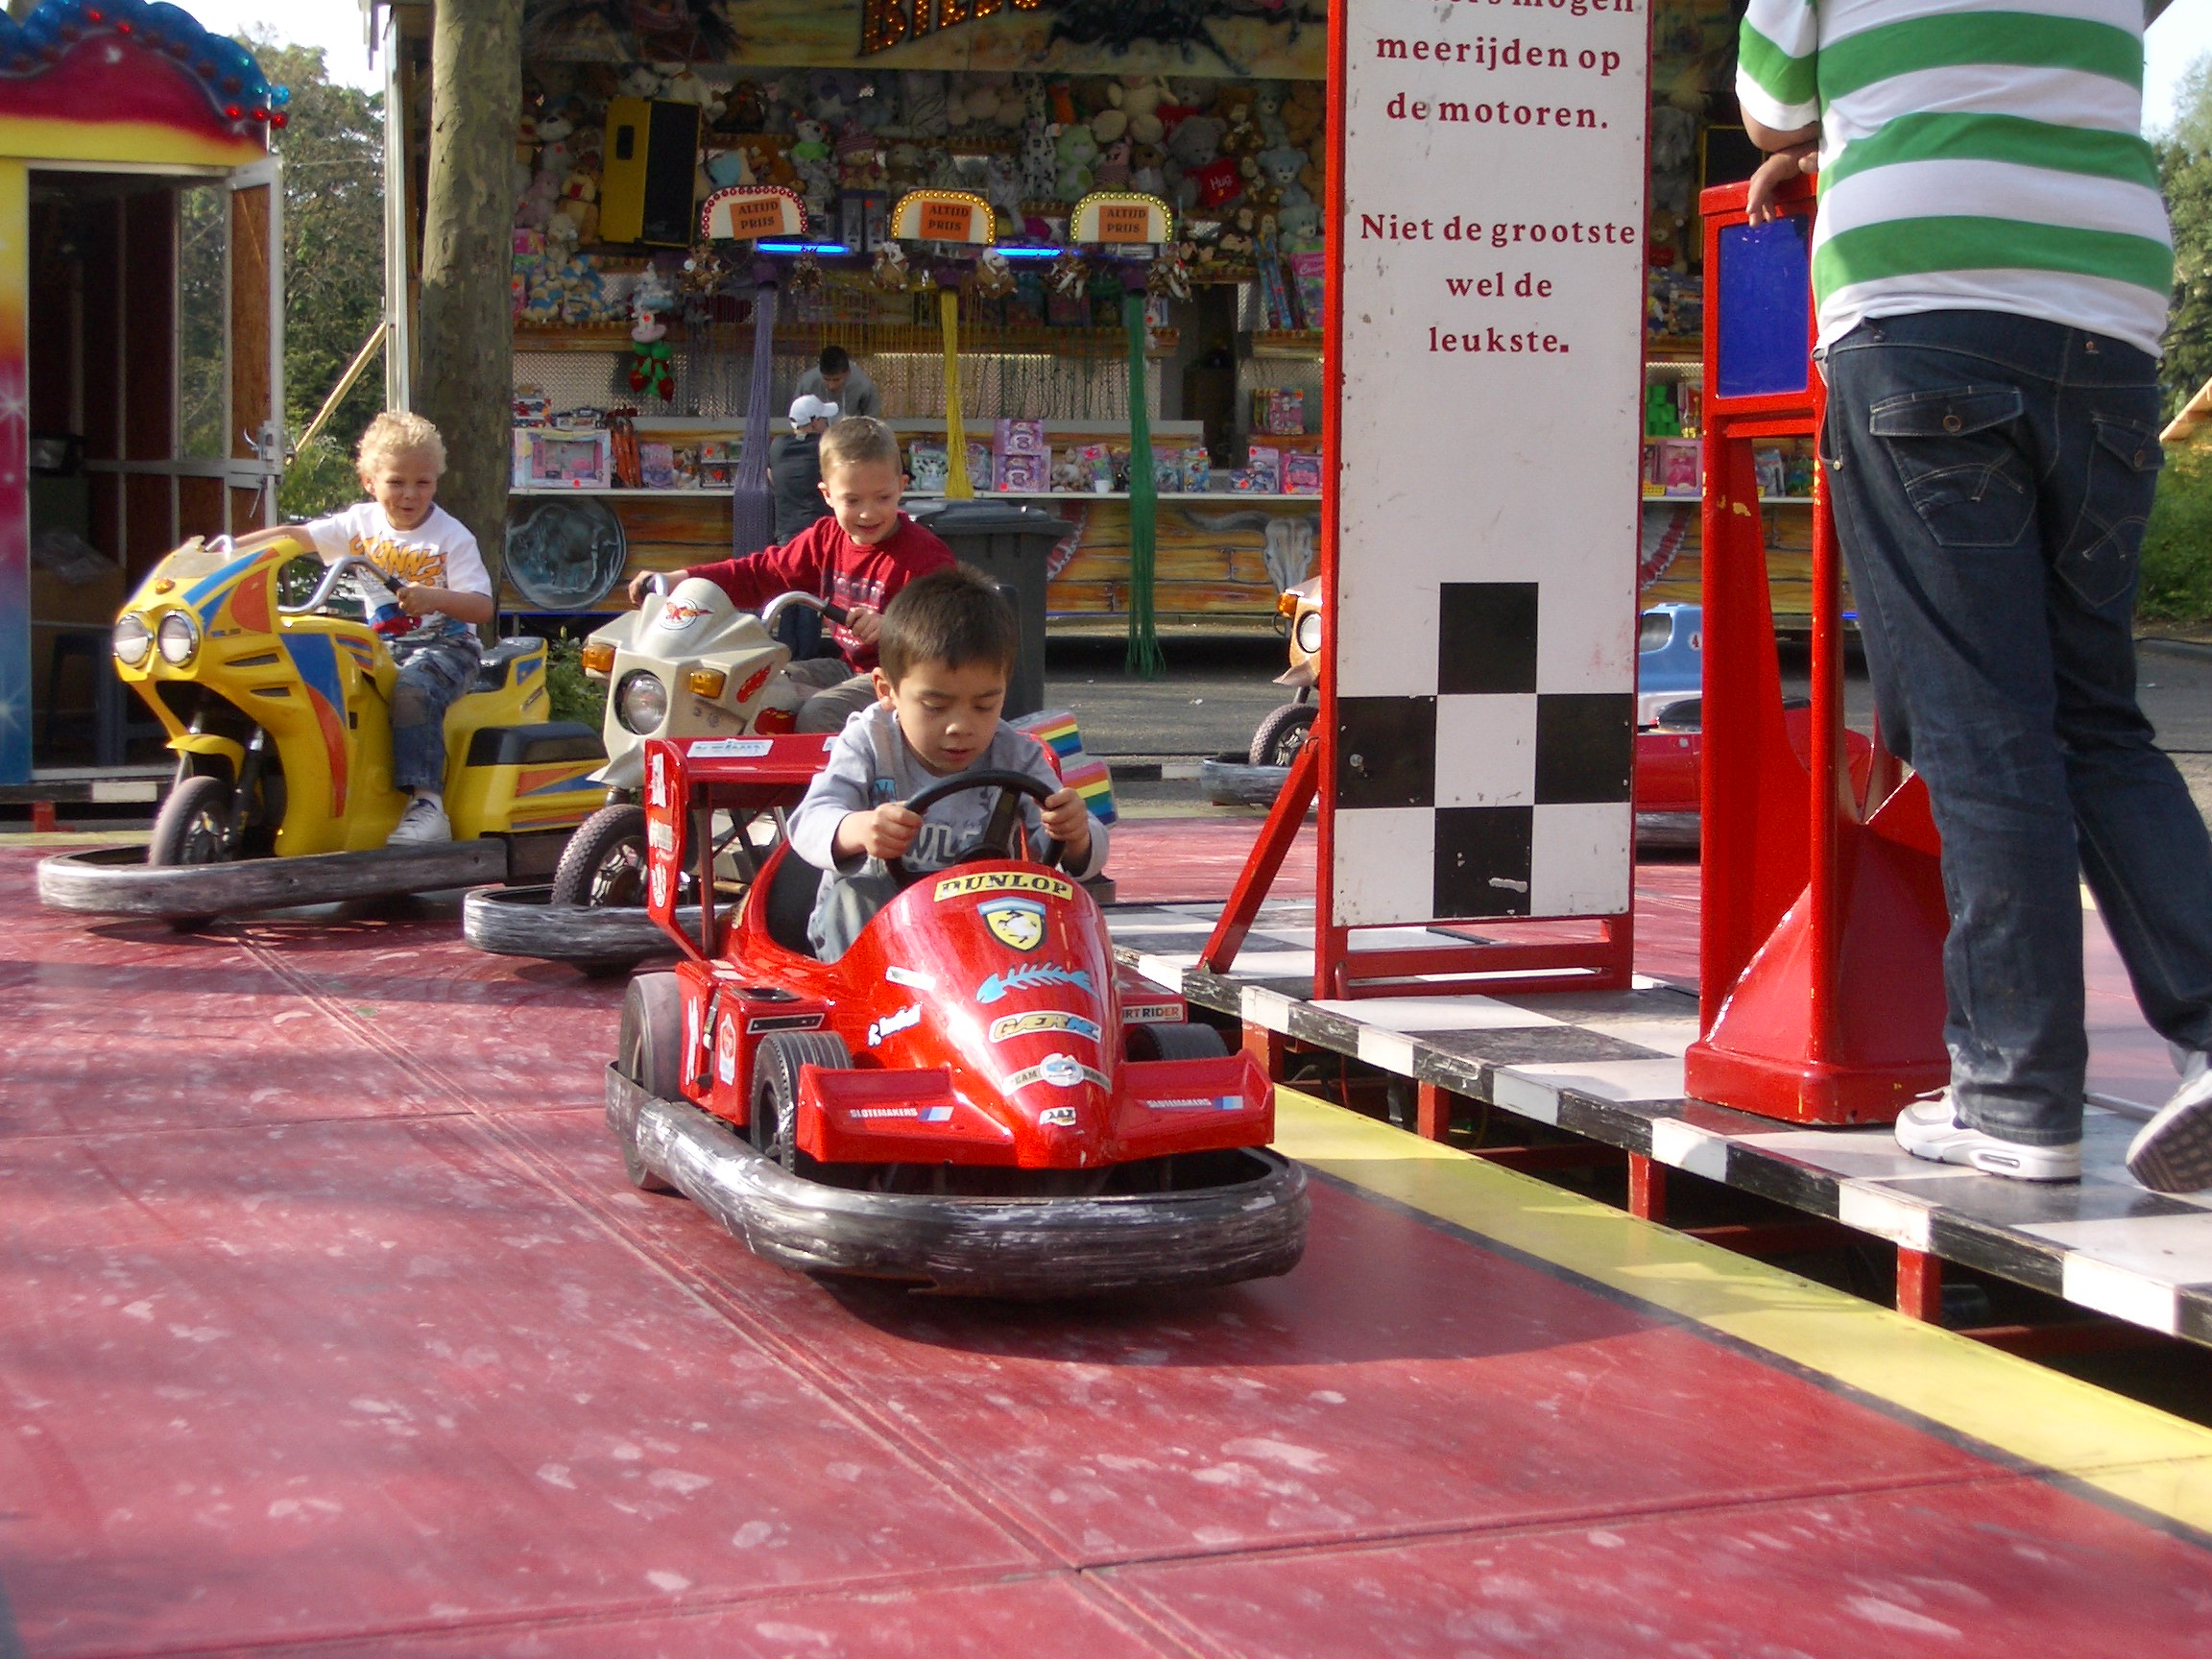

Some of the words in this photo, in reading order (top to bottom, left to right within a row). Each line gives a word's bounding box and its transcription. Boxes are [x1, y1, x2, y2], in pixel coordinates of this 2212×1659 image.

[1376, 36, 1569, 71] meerijden
[1578, 49, 1622, 77] op
[1386, 92, 1430, 121] de
[1439, 100, 1608, 130] motoren.
[1360, 214, 1434, 241] Niet
[1443, 215, 1482, 242] de
[1492, 221, 1636, 249] grootste
[1446, 273, 1505, 298] wel
[1514, 273, 1553, 298] de
[1429, 327, 1570, 353] leukste.
[942, 874, 1068, 896] DUNLOP
[1142, 1006, 1179, 1019] RIDER
